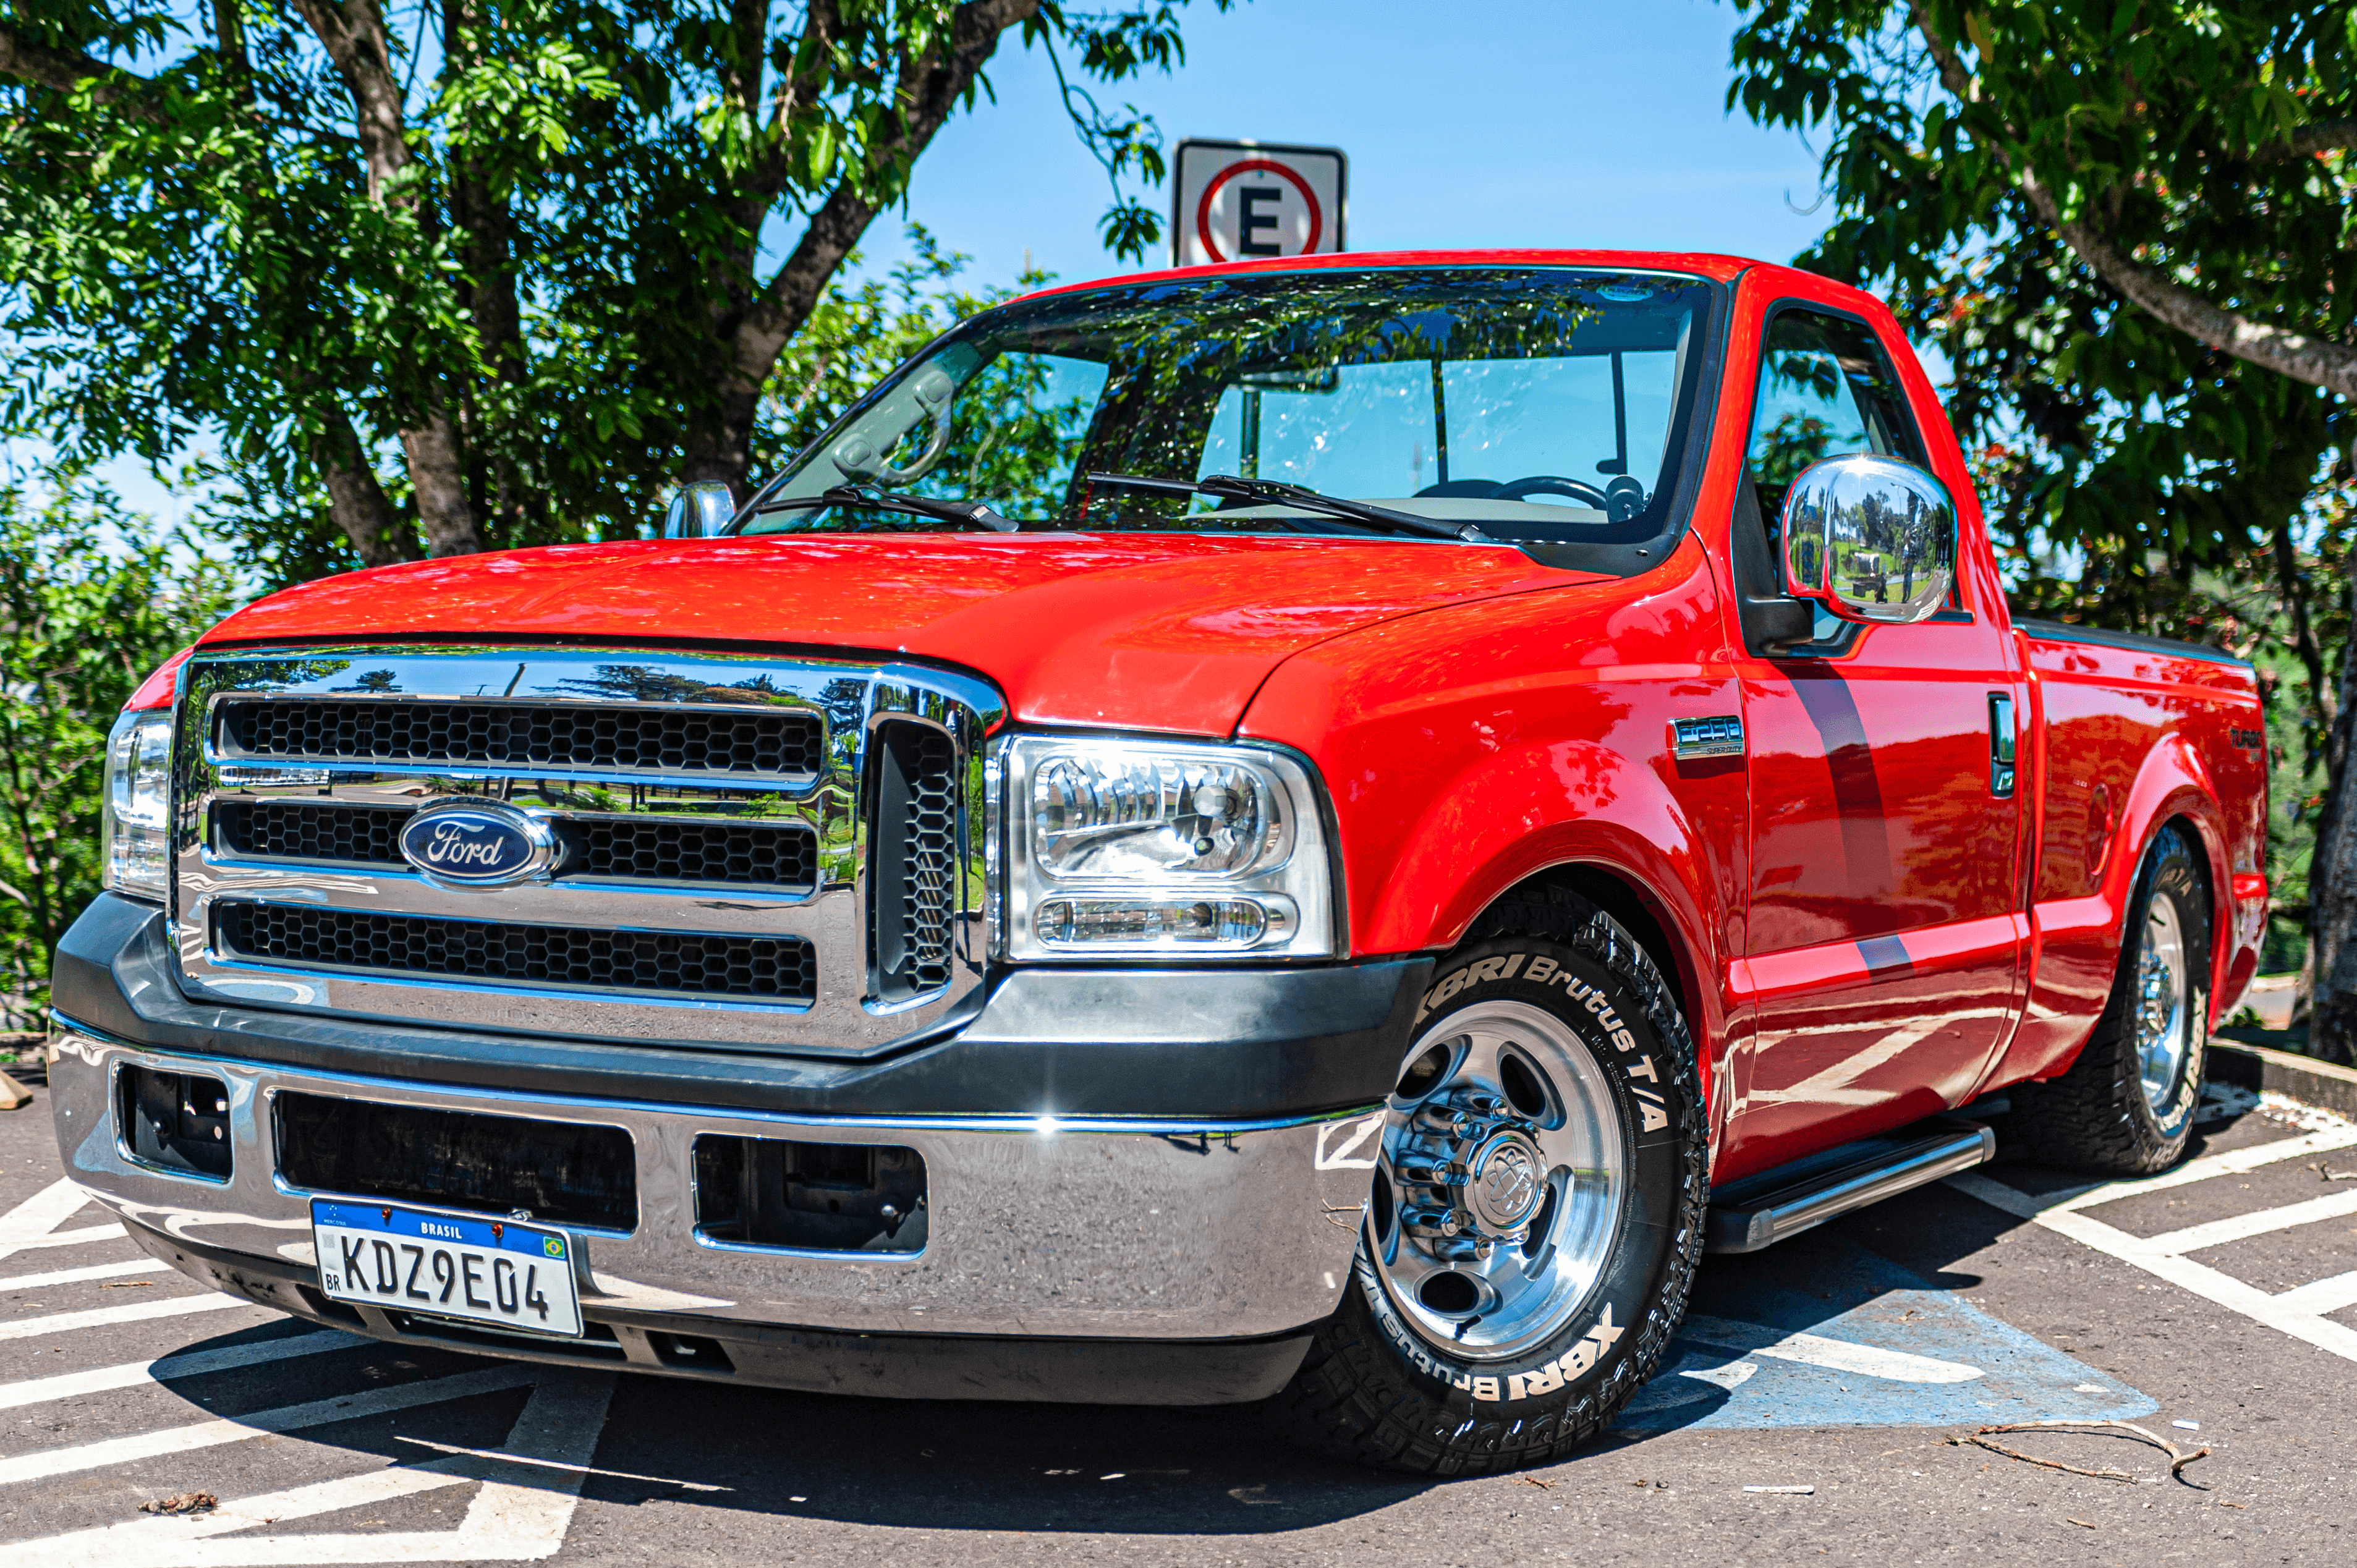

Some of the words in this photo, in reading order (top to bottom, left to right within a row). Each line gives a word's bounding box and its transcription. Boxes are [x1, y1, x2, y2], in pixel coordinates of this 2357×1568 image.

[1239, 187, 1282, 256] E
[428, 820, 504, 865] Ford
[1522, 956, 1636, 1052] Brutus
[1626, 1054, 1668, 1133] T/A
[420, 1222, 462, 1239] BRASIL
[326, 1273, 341, 1292] BR
[341, 1235, 549, 1320] KDZ9E04
[1382, 1313, 1500, 1402] Brutus
[1507, 1302, 1625, 1401] XBRI
